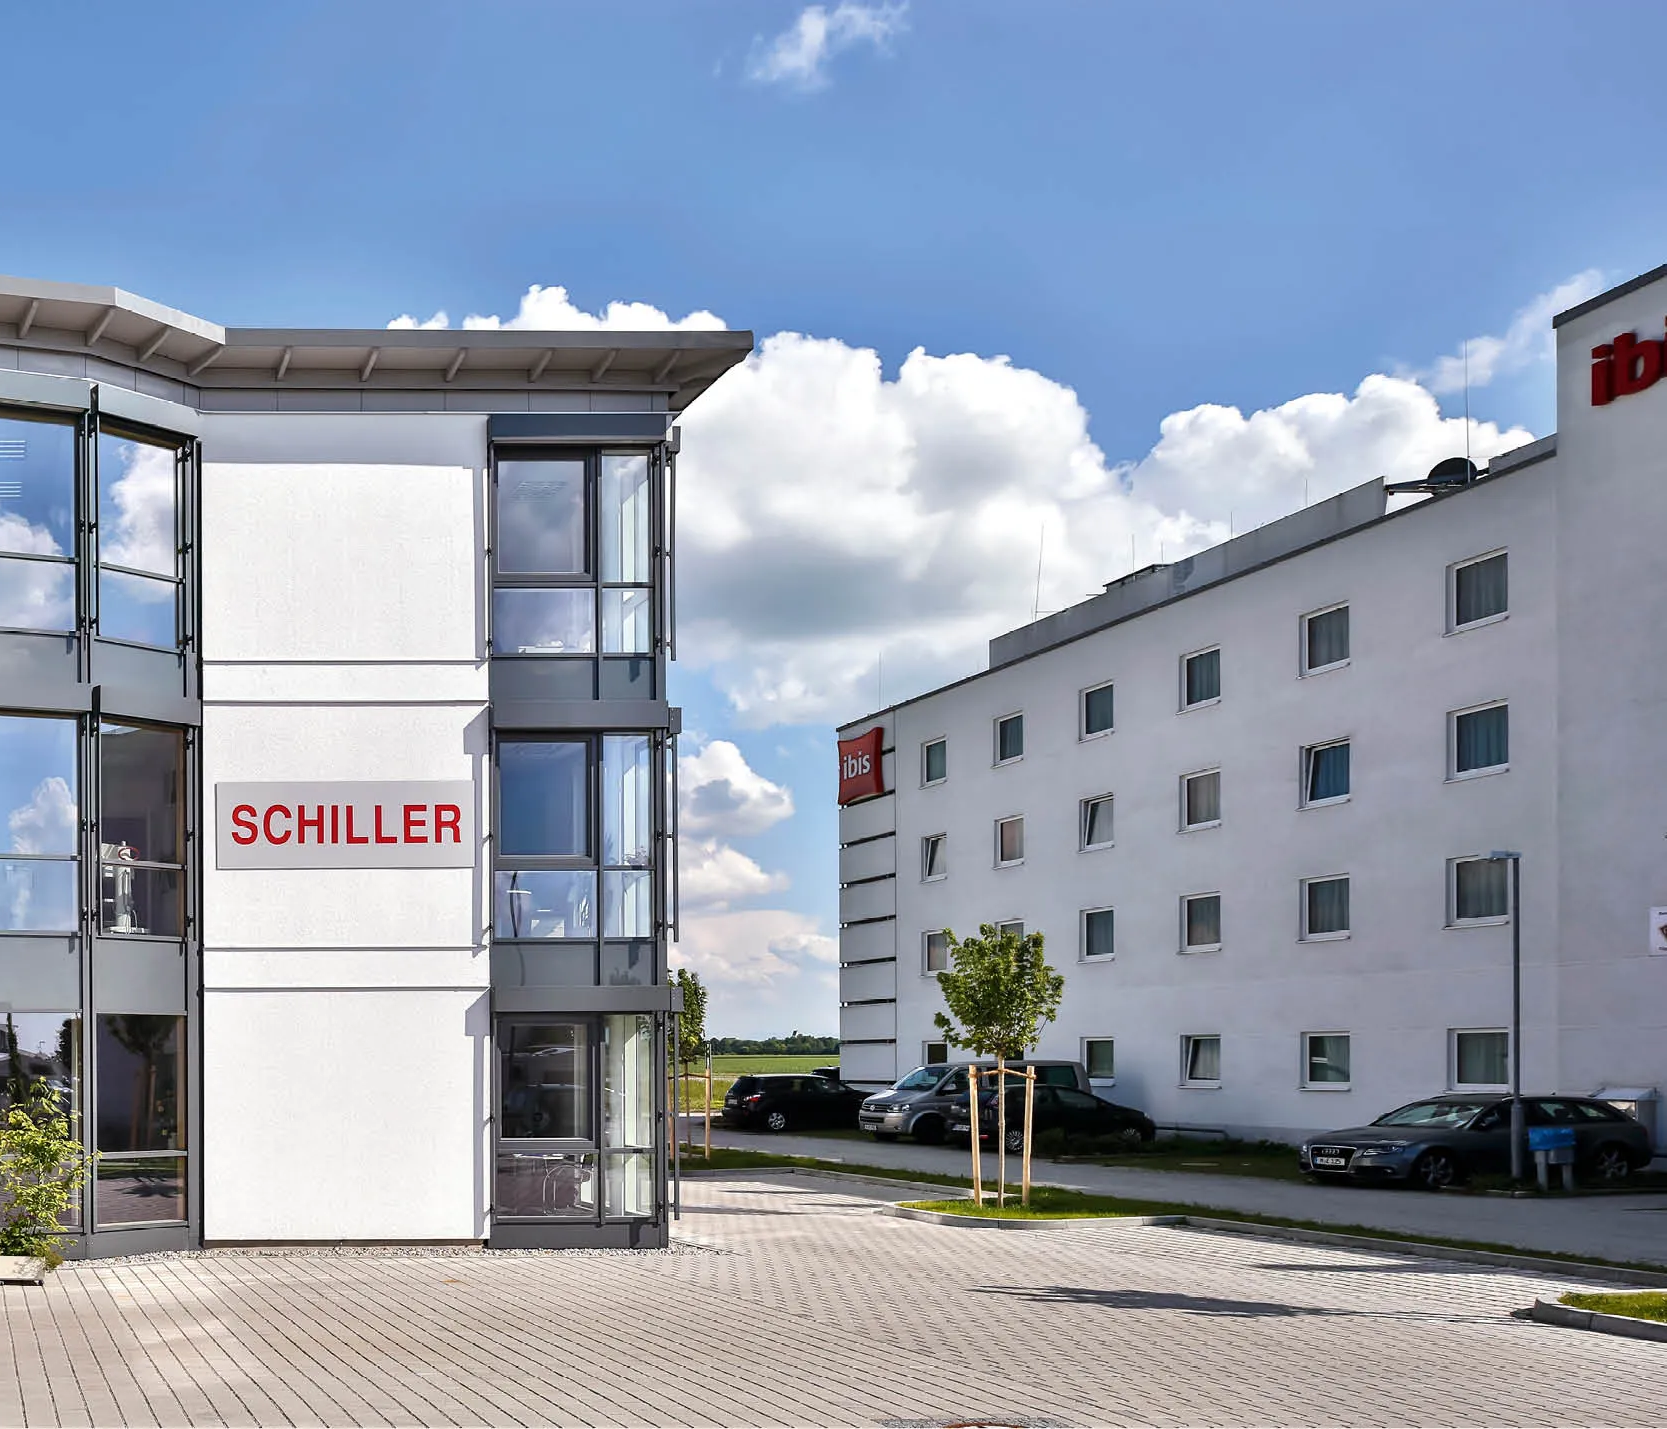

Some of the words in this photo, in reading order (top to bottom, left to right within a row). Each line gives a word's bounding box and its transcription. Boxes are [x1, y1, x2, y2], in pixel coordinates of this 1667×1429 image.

[1591, 315, 1667, 406] ib
[843, 750, 871, 780] ibis
[231, 804, 462, 845] SCHILLER
